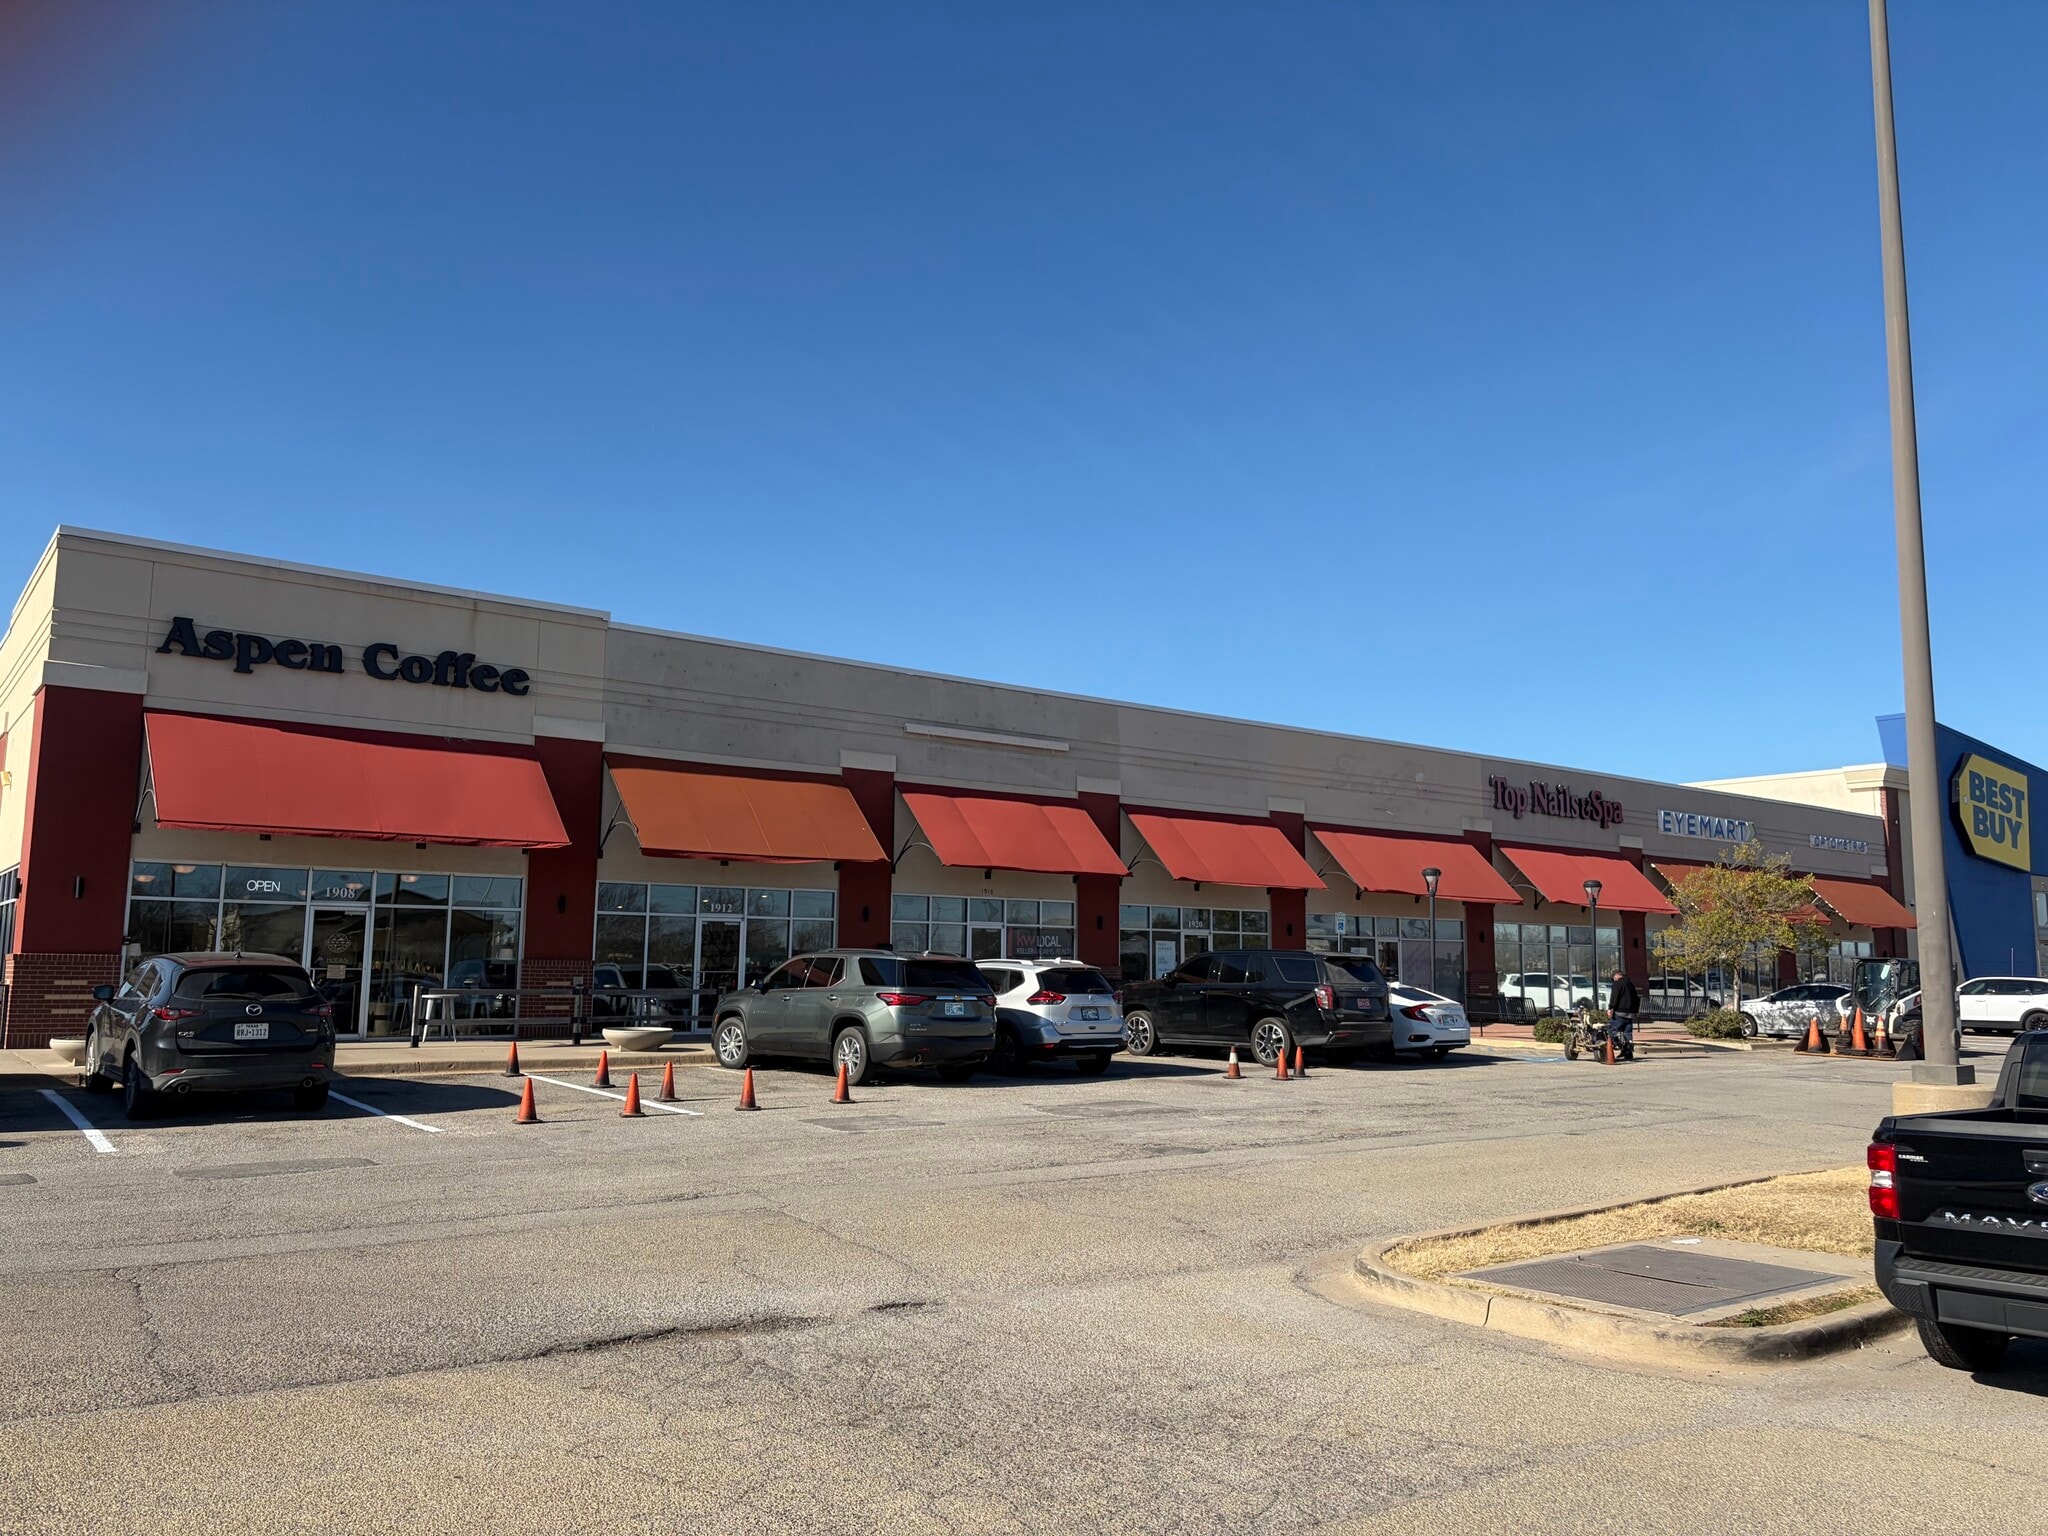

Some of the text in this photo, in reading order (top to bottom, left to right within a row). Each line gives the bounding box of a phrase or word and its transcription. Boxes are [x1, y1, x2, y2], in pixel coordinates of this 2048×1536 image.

[156, 616, 529, 696] Aspen Coffee
[1489, 774, 1528, 819] Top
[1530, 780, 1579, 818] Nails
[1589, 790, 1623, 829] Spa
[1969, 769, 2025, 819] BEST
[1661, 810, 1746, 841] EYEMART
[1972, 804, 2023, 850] BUY
[246, 879, 281, 892] OPEN
[325, 886, 356, 899] 1908
[710, 903, 733, 913] 1912
[1187, 920, 1203, 928] 1920
[1945, 1211, 2048, 1233] MAV
